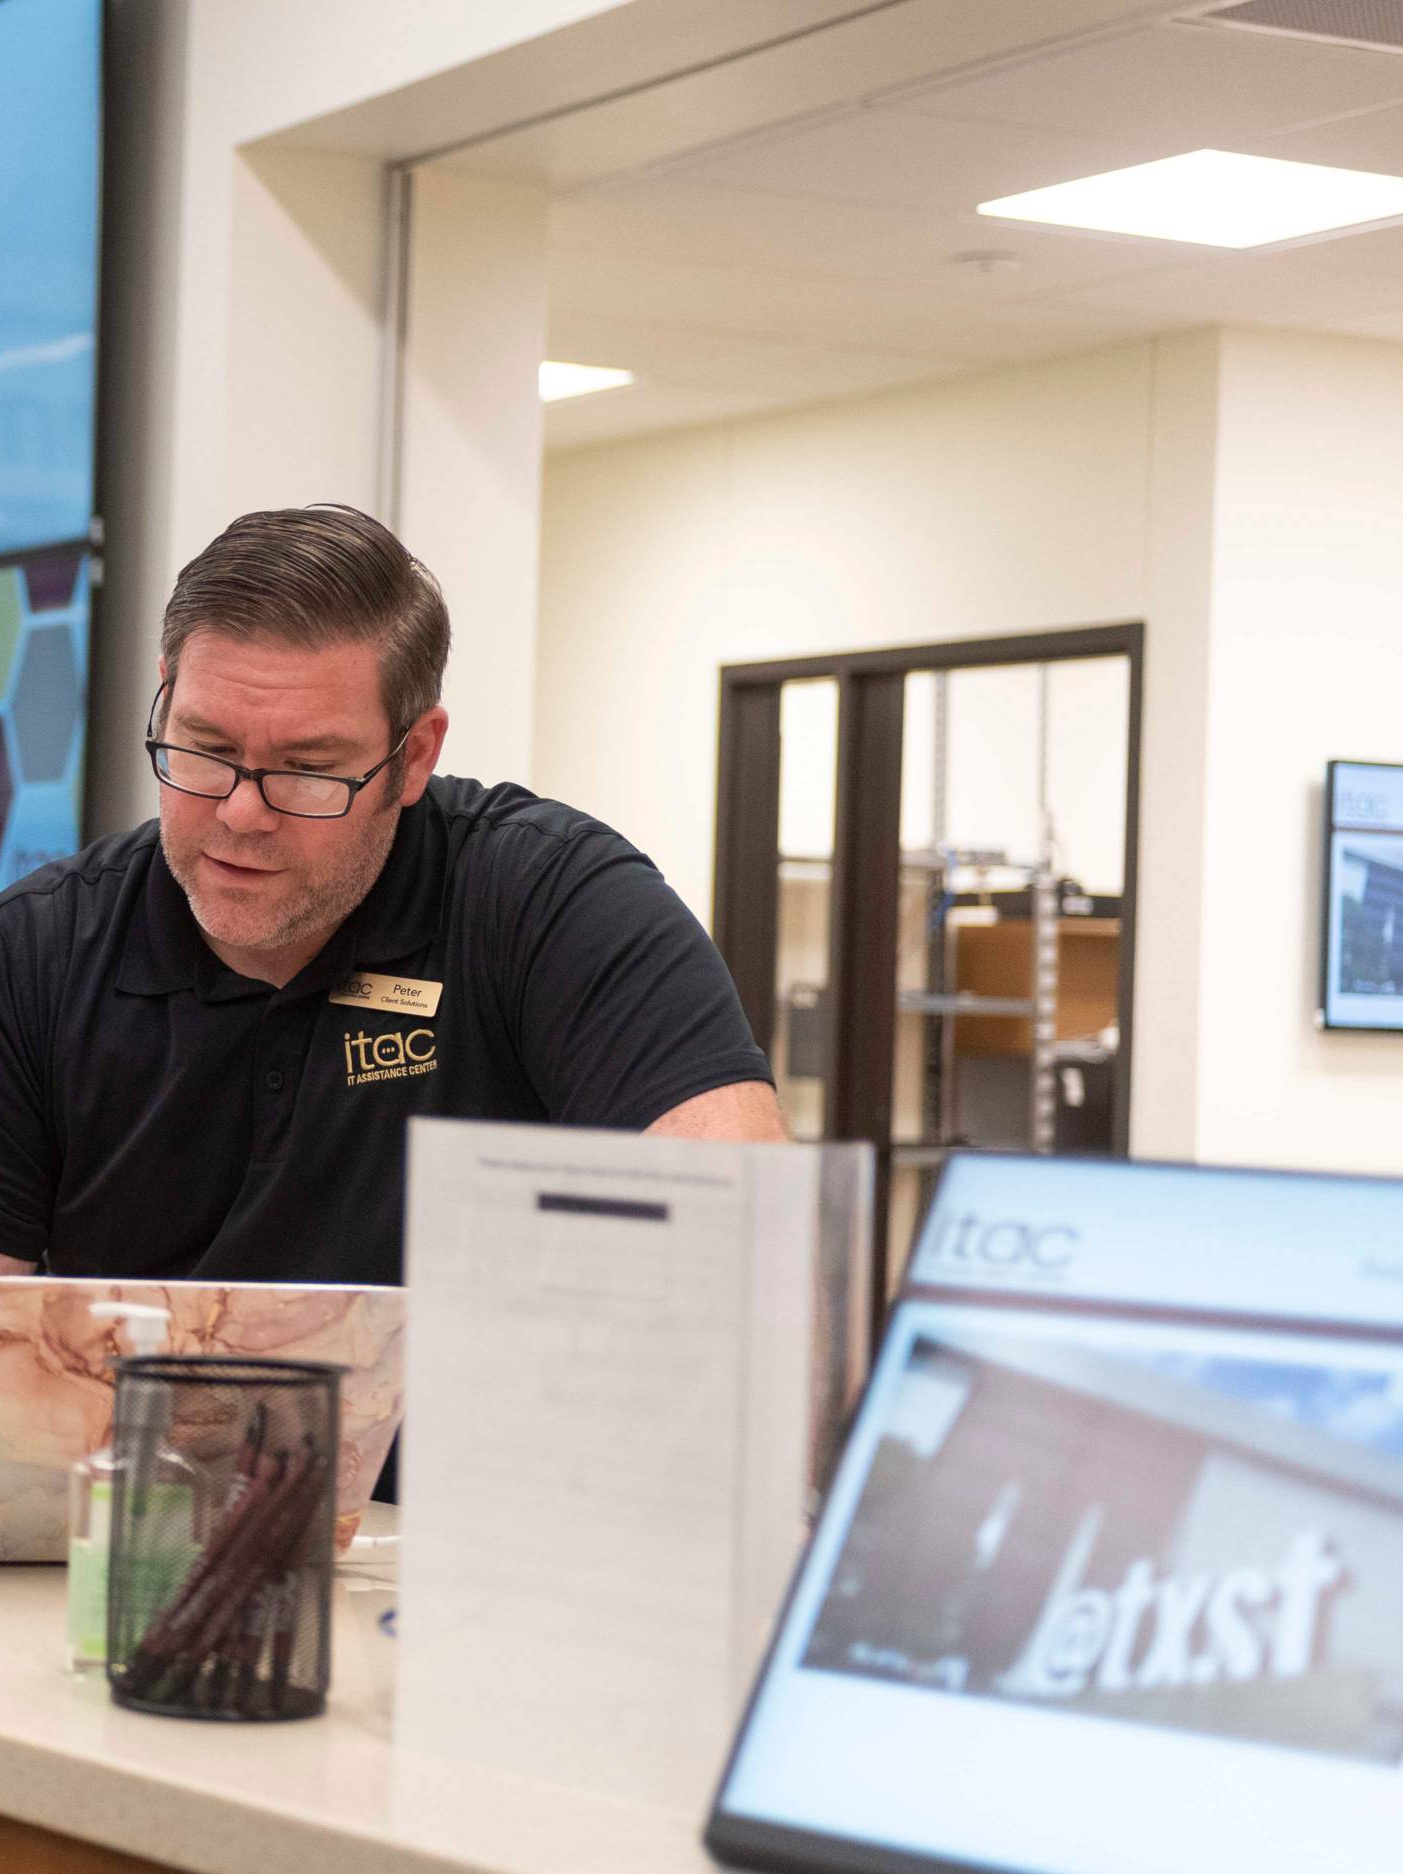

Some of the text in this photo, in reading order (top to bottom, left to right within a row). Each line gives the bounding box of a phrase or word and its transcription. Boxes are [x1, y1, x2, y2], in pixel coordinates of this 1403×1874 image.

[393, 984, 422, 997] Peter
[381, 996, 398, 1005] Client
[400, 999, 428, 1009] Solutions
[344, 1028, 436, 1074] itac
[347, 1059, 437, 1087] IT ASSISTANCE CENTER
